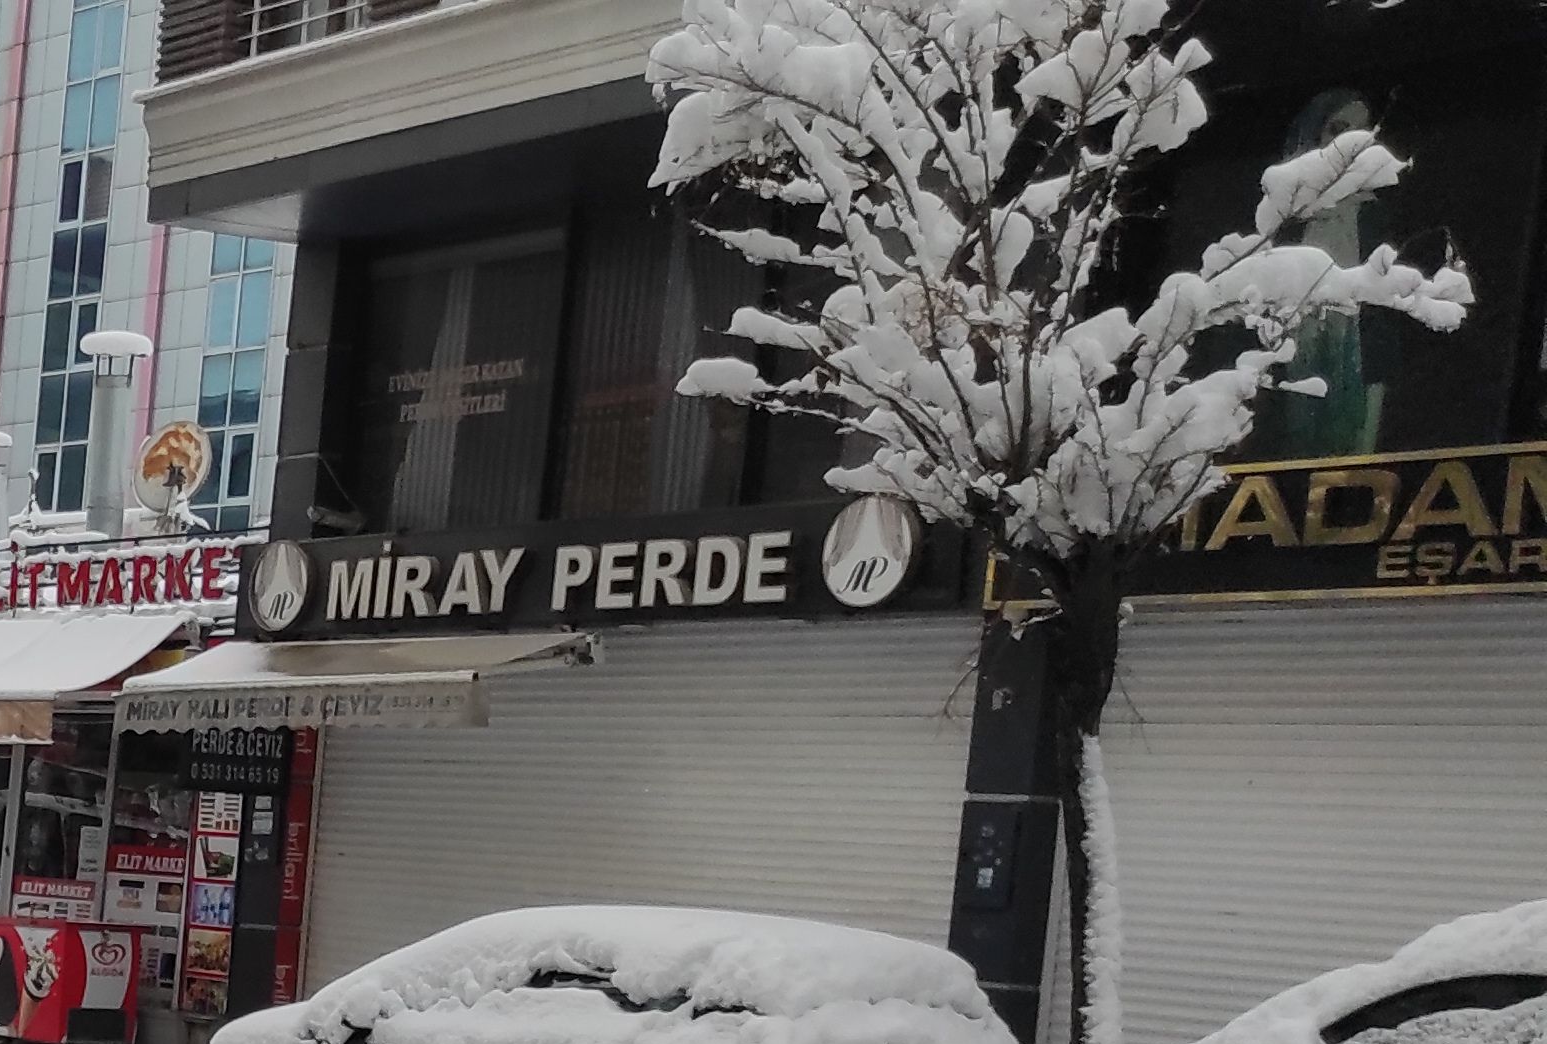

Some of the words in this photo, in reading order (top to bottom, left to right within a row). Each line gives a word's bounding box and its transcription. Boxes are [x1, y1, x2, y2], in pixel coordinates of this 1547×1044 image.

[56, 545, 242, 608] MARKE
[324, 540, 526, 622] MİRAY
[551, 530, 793, 613] PERDE
[124, 694, 182, 721] MİRAY
